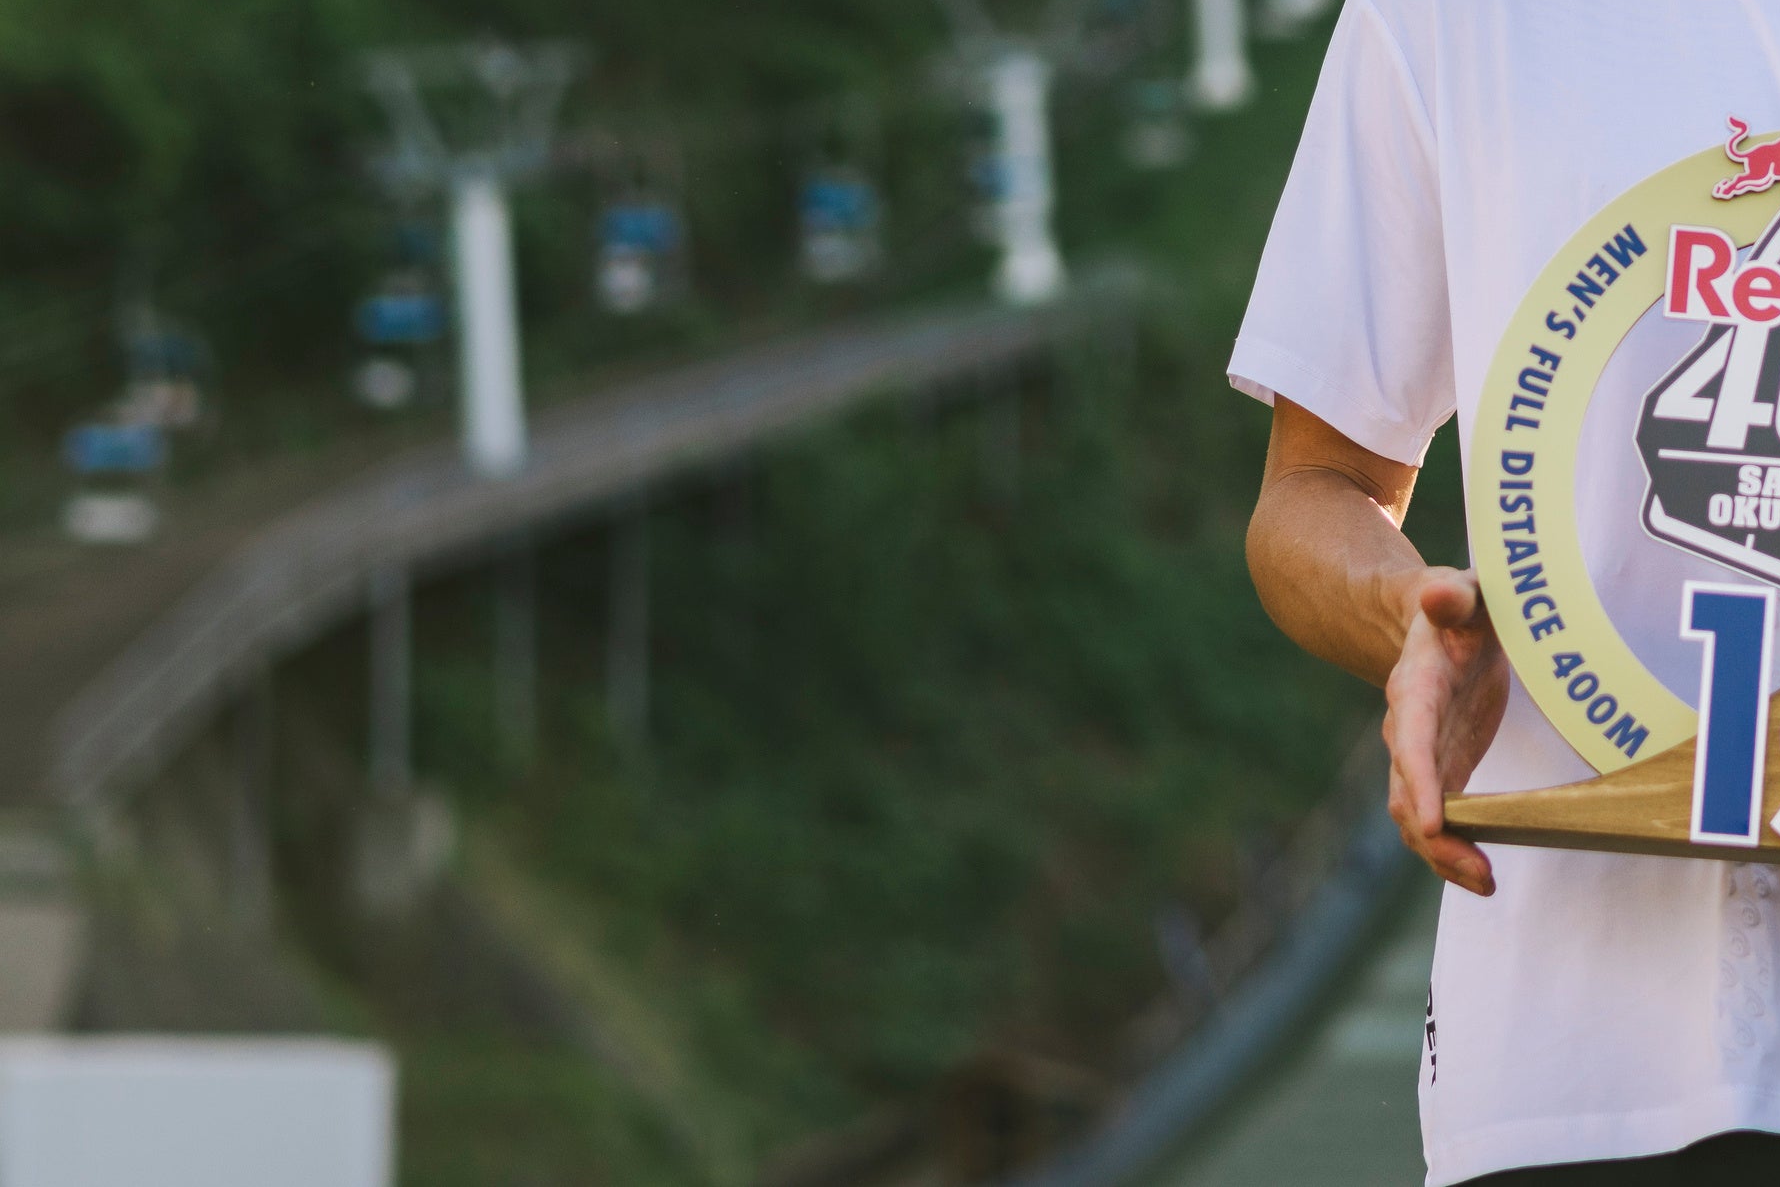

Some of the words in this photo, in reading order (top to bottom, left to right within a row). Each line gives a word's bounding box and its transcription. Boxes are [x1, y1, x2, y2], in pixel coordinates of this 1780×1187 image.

[1545, 223, 1648, 340] MEN'S
[1505, 344, 1562, 431] FULL
[1499, 450, 1565, 642] DISTANCE
[1552, 651, 1650, 759] 400M
